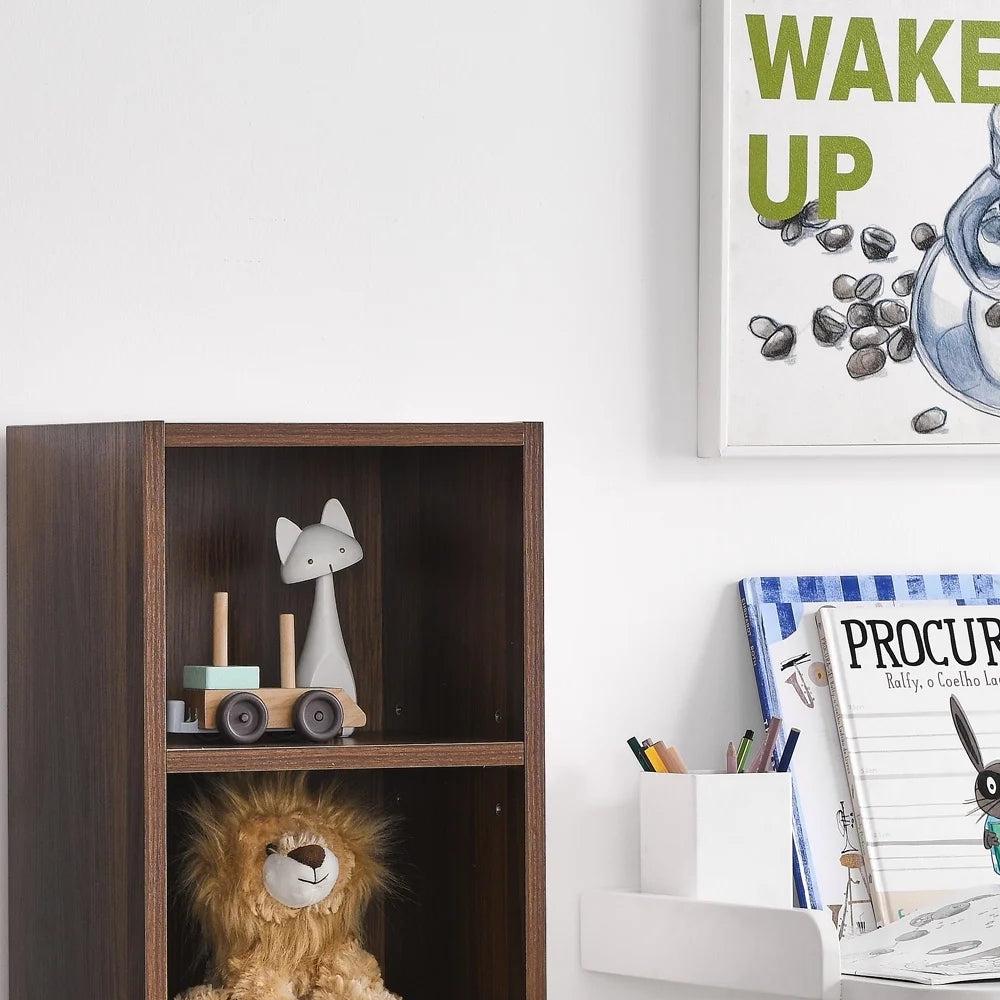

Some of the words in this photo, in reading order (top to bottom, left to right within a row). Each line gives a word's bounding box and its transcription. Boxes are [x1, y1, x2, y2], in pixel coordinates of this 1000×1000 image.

[745, 14, 1000, 104] WAKE
[748, 134, 873, 221] UP
[840, 617, 1000, 668] PROCUR
[885, 672, 923, 693] Ralfy,
[927, 679, 935, 688] o
[937, 671, 981, 688] Coelho
[983, 670, 1000, 686] La
